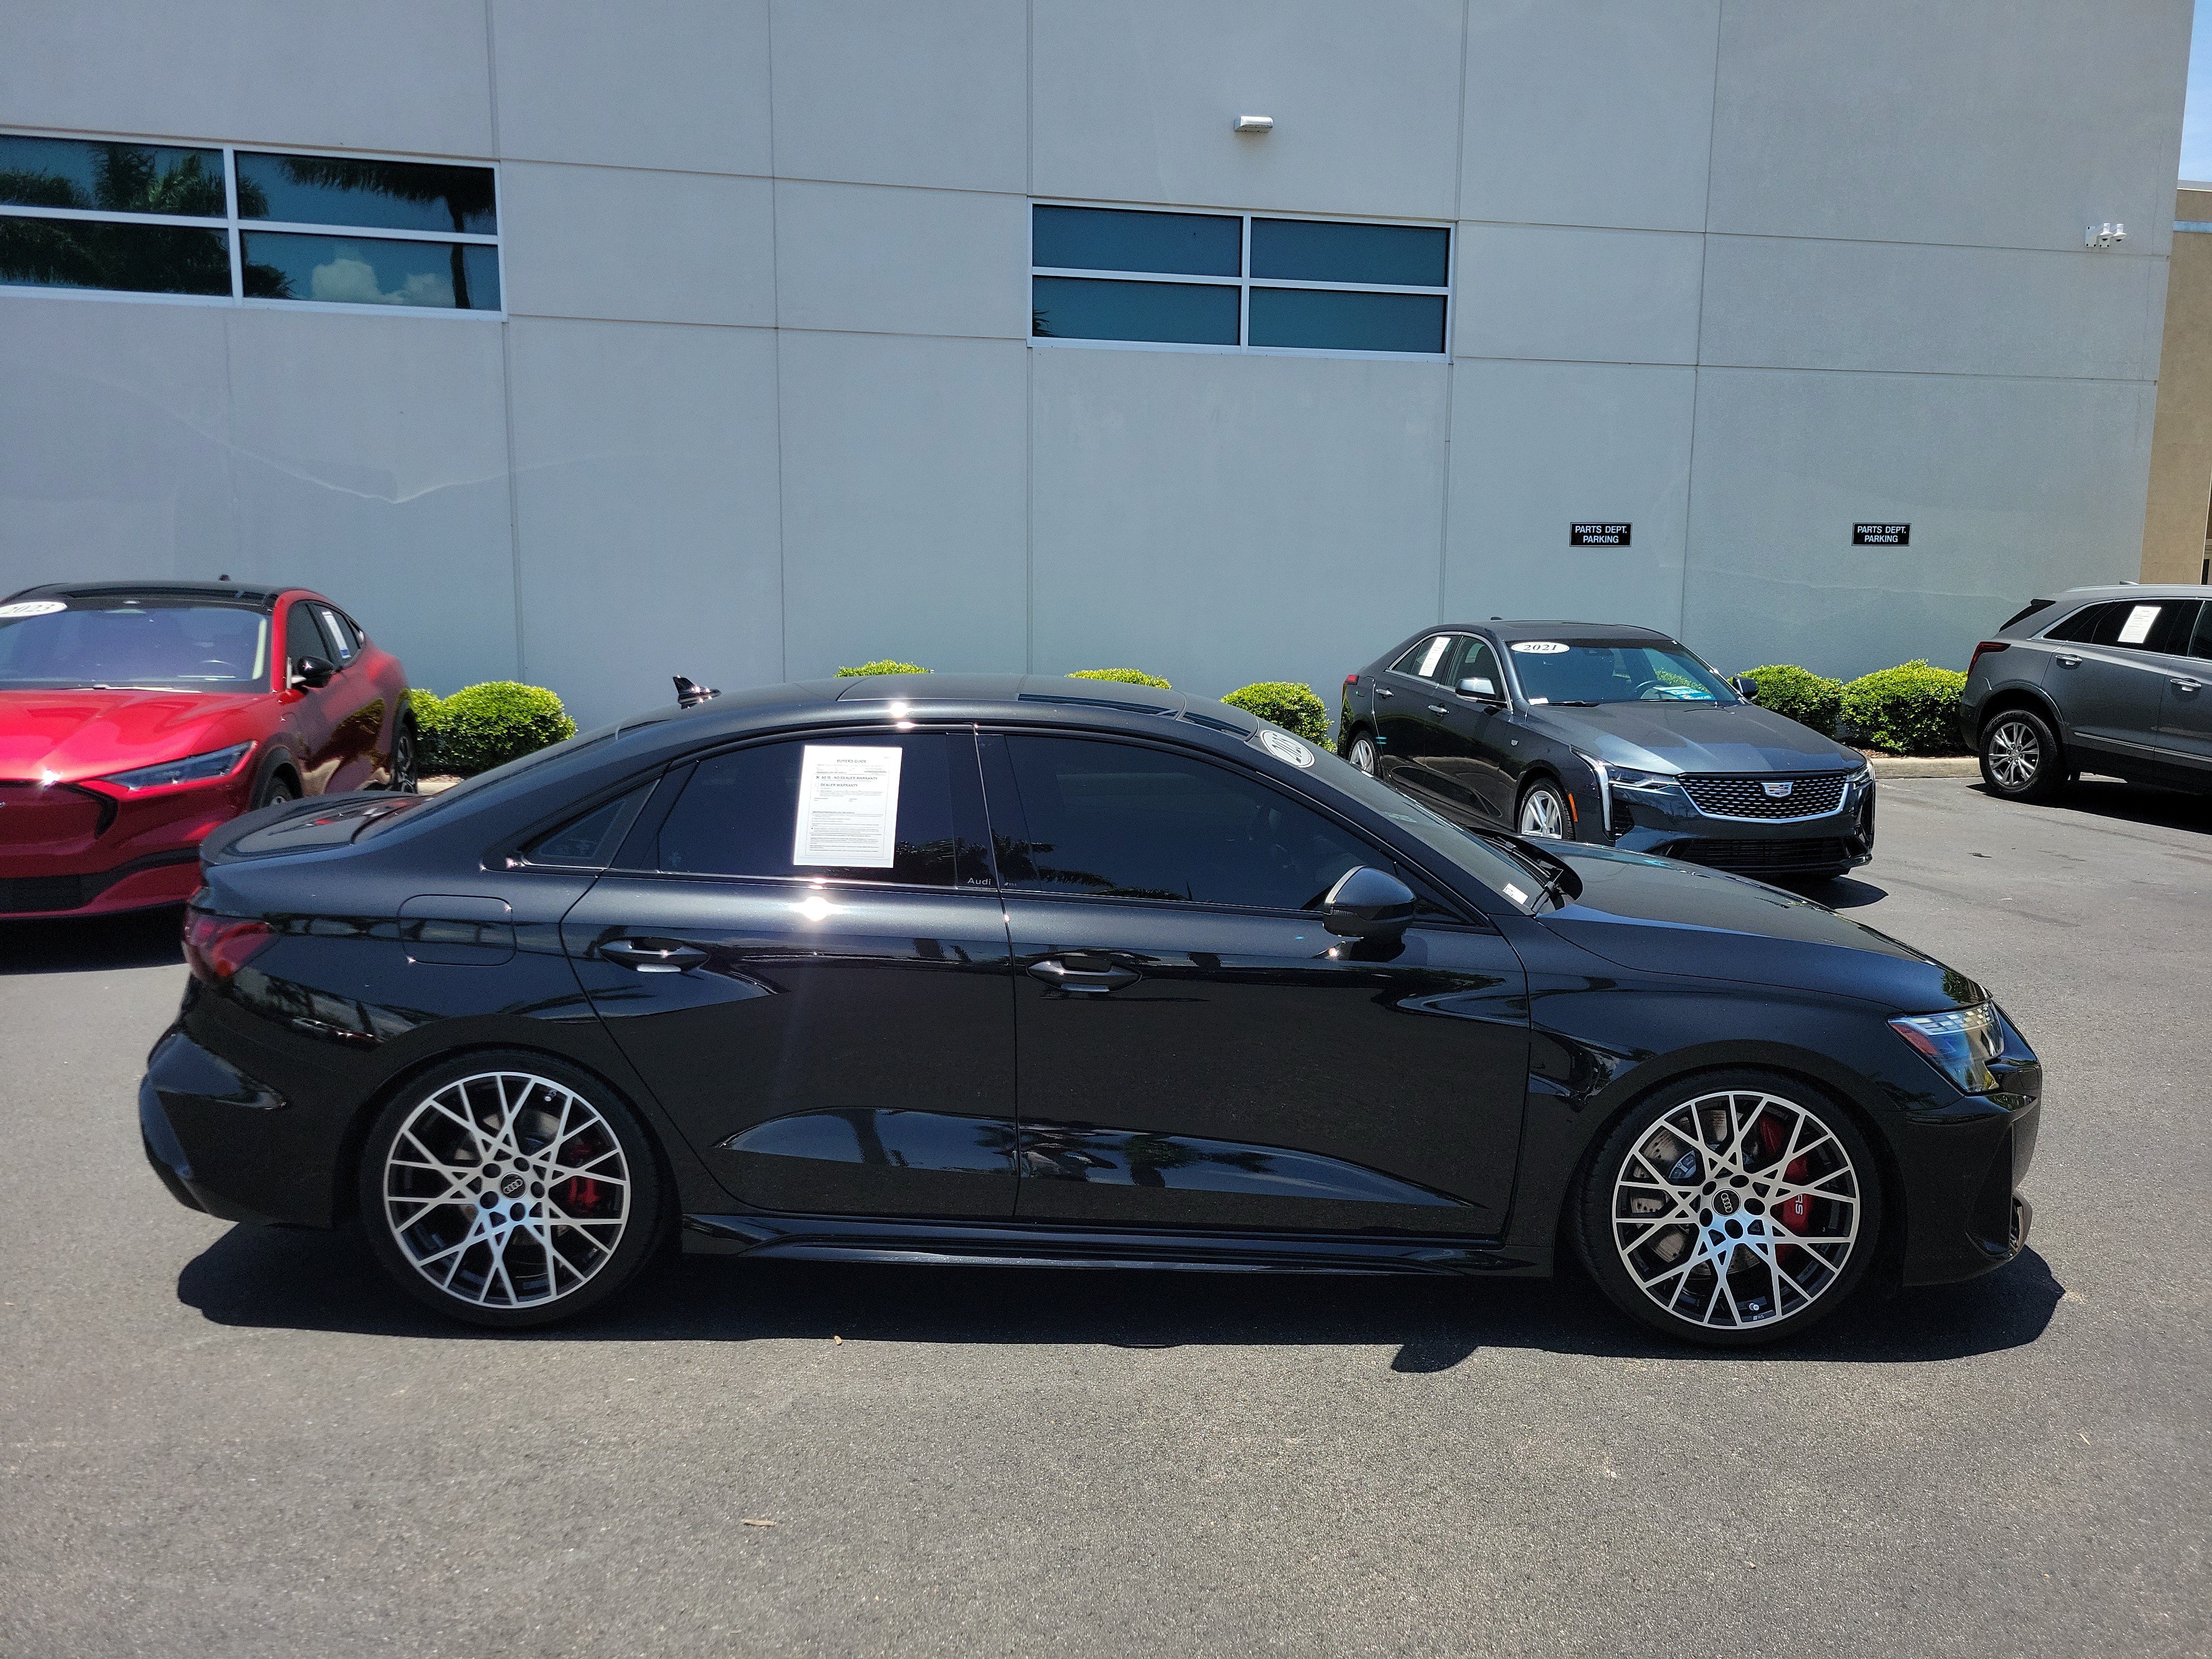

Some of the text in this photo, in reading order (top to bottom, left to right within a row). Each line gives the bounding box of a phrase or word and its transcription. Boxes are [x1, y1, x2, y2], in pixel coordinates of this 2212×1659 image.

[1, 604, 55, 614] 2023
[1271, 731, 1302, 764] 2025
[1795, 1194, 1803, 1215] RS
